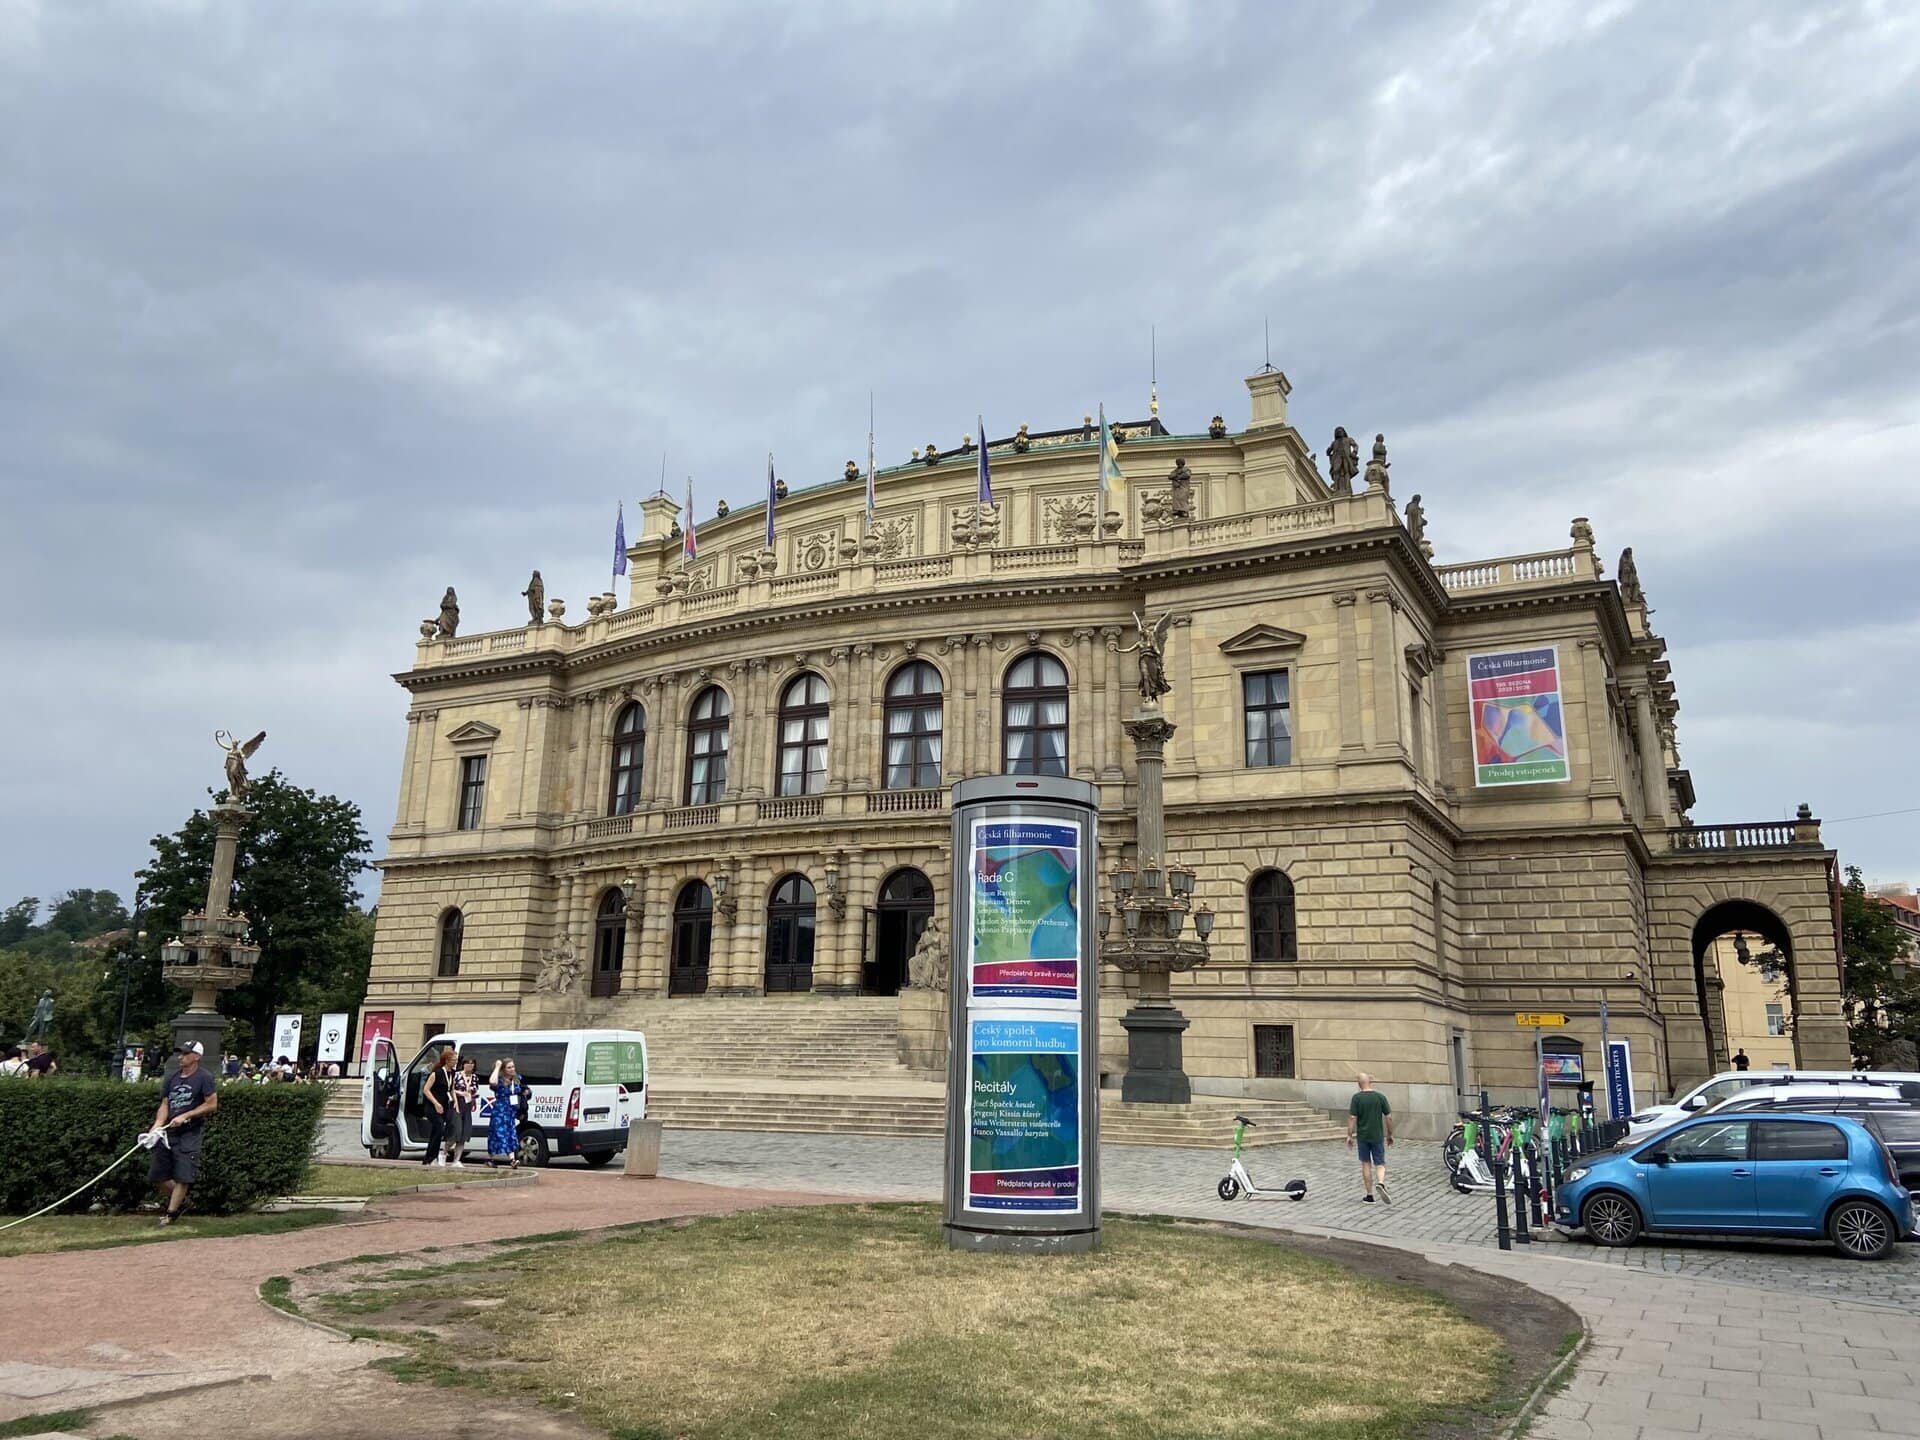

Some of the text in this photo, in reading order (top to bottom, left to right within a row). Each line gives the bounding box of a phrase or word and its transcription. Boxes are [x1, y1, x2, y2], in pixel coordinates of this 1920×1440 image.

[1478, 657, 1547, 671] Česká filharmonie
[1488, 765, 1556, 778] Prodej vstupenek
[978, 829, 1001, 839] Česká
[1003, 828, 1052, 840] filharmonie
[978, 870, 1014, 883] Řada C
[999, 969, 1033, 977] Předplatné
[1034, 970, 1051, 978] právě
[974, 1023, 1035, 1037] Český spolek
[974, 1037, 1066, 1049] pro komorní hudbu
[974, 1080, 1017, 1095] Recitály
[535, 1096, 564, 1104] VOLEJTE
[1615, 1082, 1625, 1120] STUPENKY
[999, 1109, 1020, 1118] Kissin
[973, 1128, 994, 1136] Franco
[995, 1128, 1023, 1137] Vassallo
[997, 1179, 1032, 1188] Předplatné
[1033, 1180, 1051, 1189] právě
